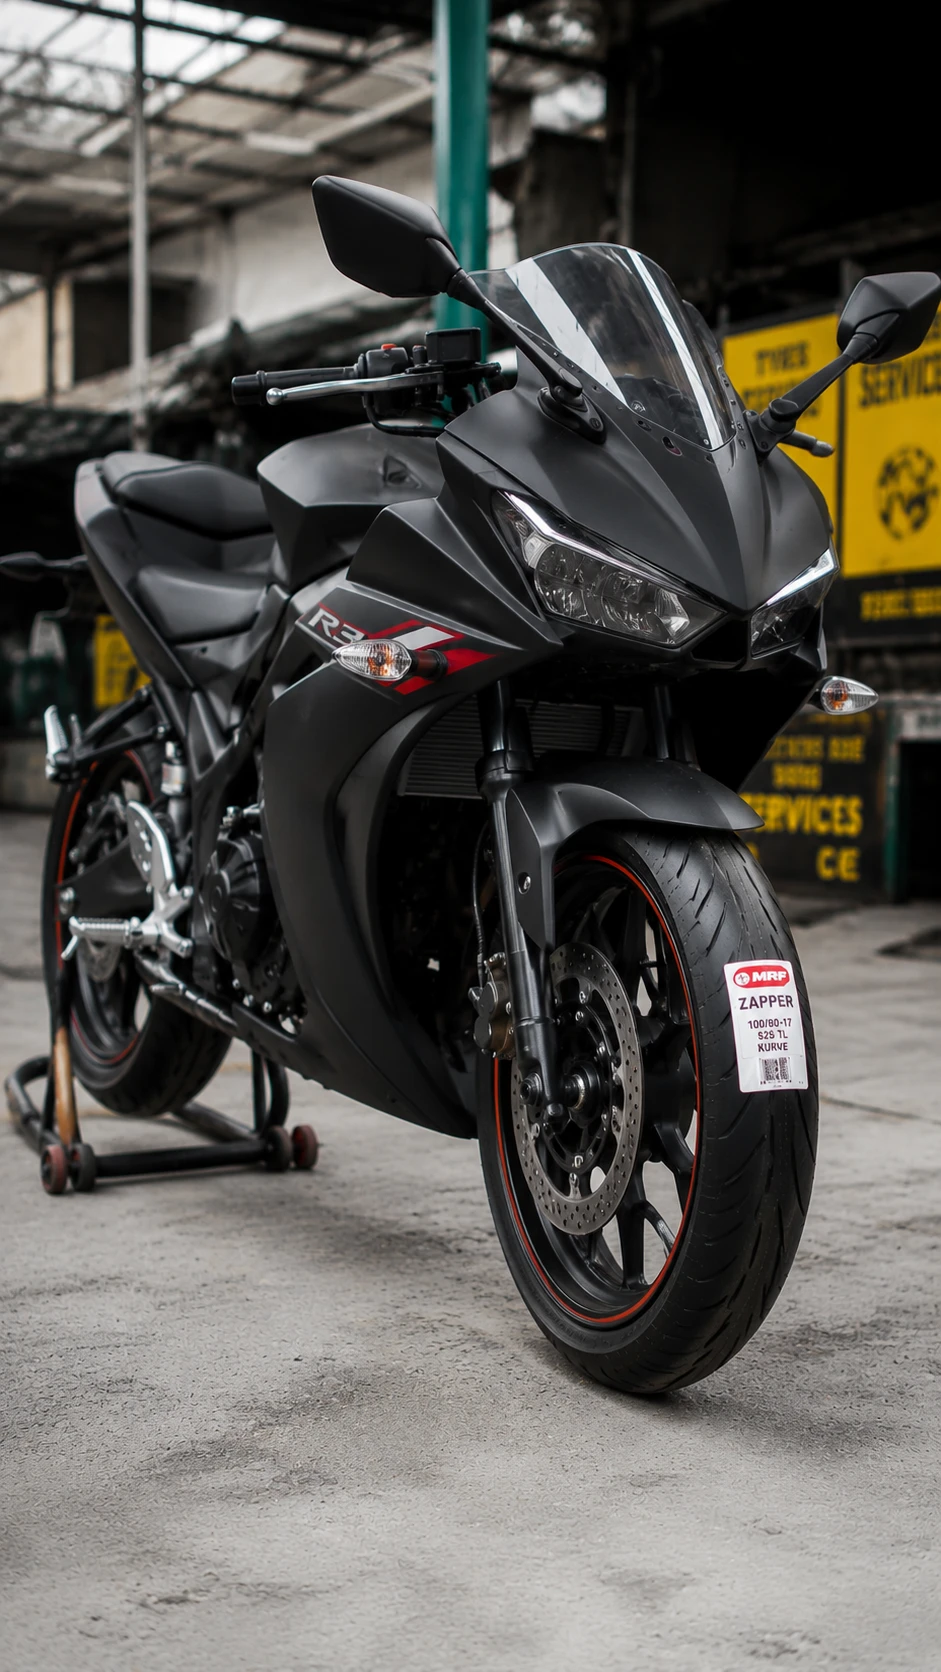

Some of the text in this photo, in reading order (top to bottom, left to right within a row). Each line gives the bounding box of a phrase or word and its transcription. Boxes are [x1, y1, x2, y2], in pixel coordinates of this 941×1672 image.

[307, 608, 366, 645] R3
[752, 971, 787, 982] MRF
[738, 995, 794, 1010] ZAPPER
[747, 1018, 792, 1029] 100/80-17
[757, 1042, 788, 1052] KURVE
